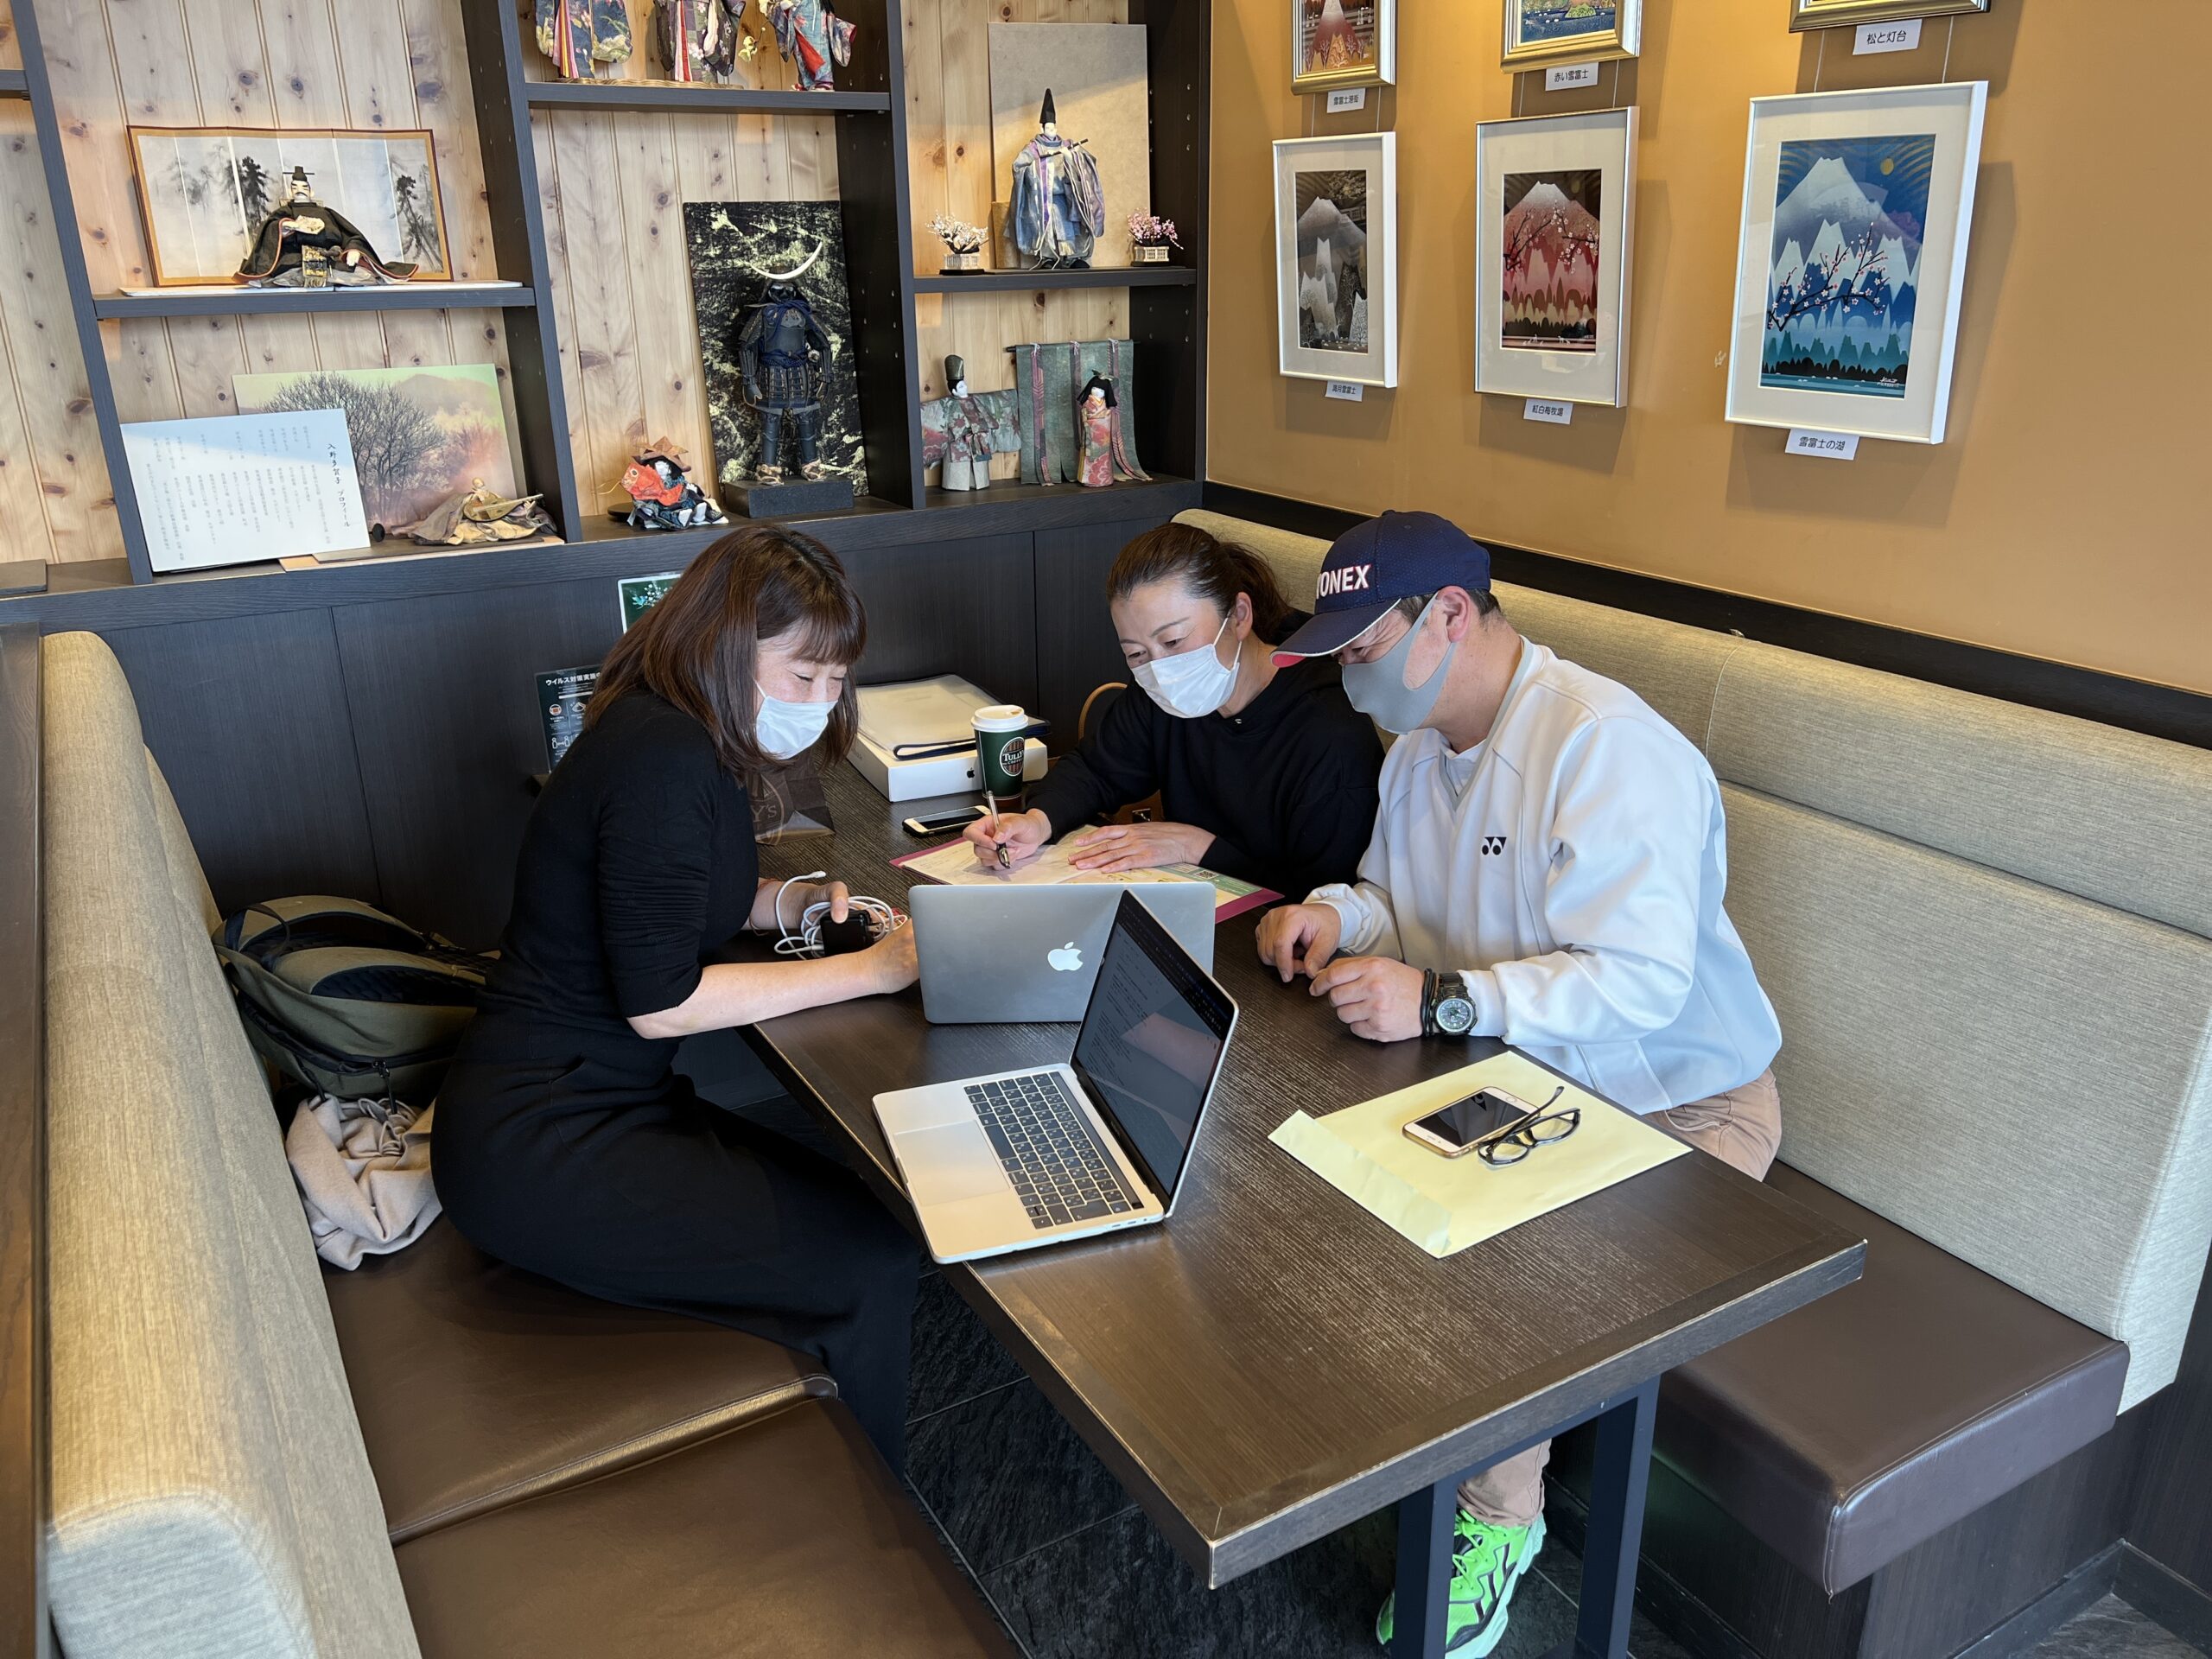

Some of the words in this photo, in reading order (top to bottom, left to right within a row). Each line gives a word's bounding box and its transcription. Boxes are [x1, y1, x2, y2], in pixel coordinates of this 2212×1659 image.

[1866, 29, 1907, 45] 松と灯台
[1554, 69, 1590, 83] 赤い雪富士
[1798, 435, 1847, 451] 雪富士の湖
